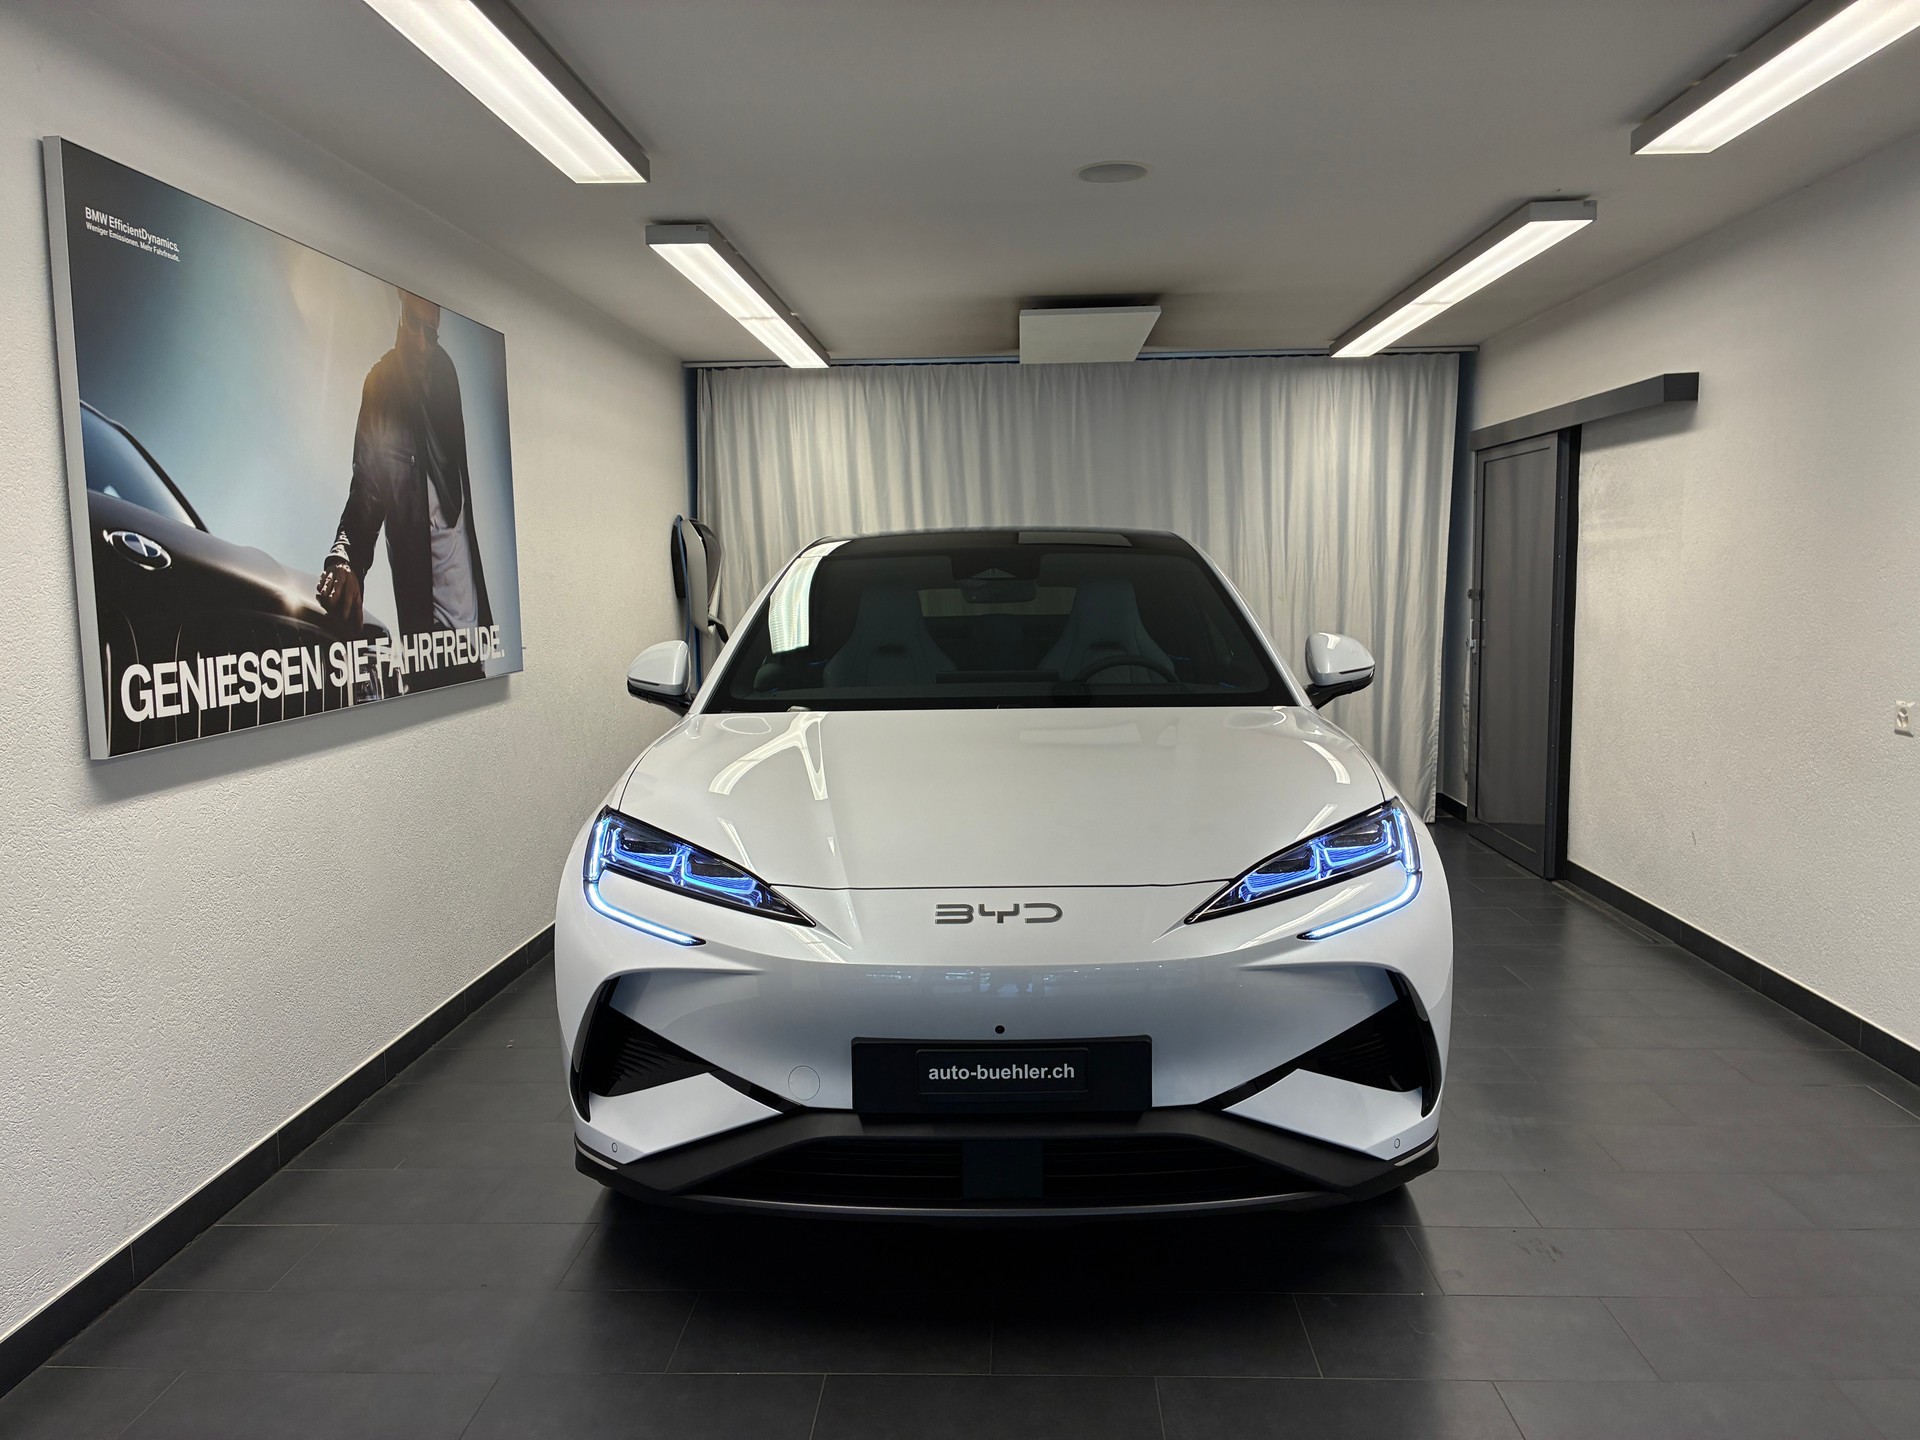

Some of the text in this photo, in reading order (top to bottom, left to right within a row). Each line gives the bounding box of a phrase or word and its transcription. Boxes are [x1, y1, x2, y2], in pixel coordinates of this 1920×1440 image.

[85, 206, 180, 253] BMW EfficientDynamics.
[120, 624, 506, 722] GENIESSEN SIE FAHRFREUDE.
[935, 902, 1063, 924] BYD
[928, 1063, 1075, 1081] auto-buehler.ch
